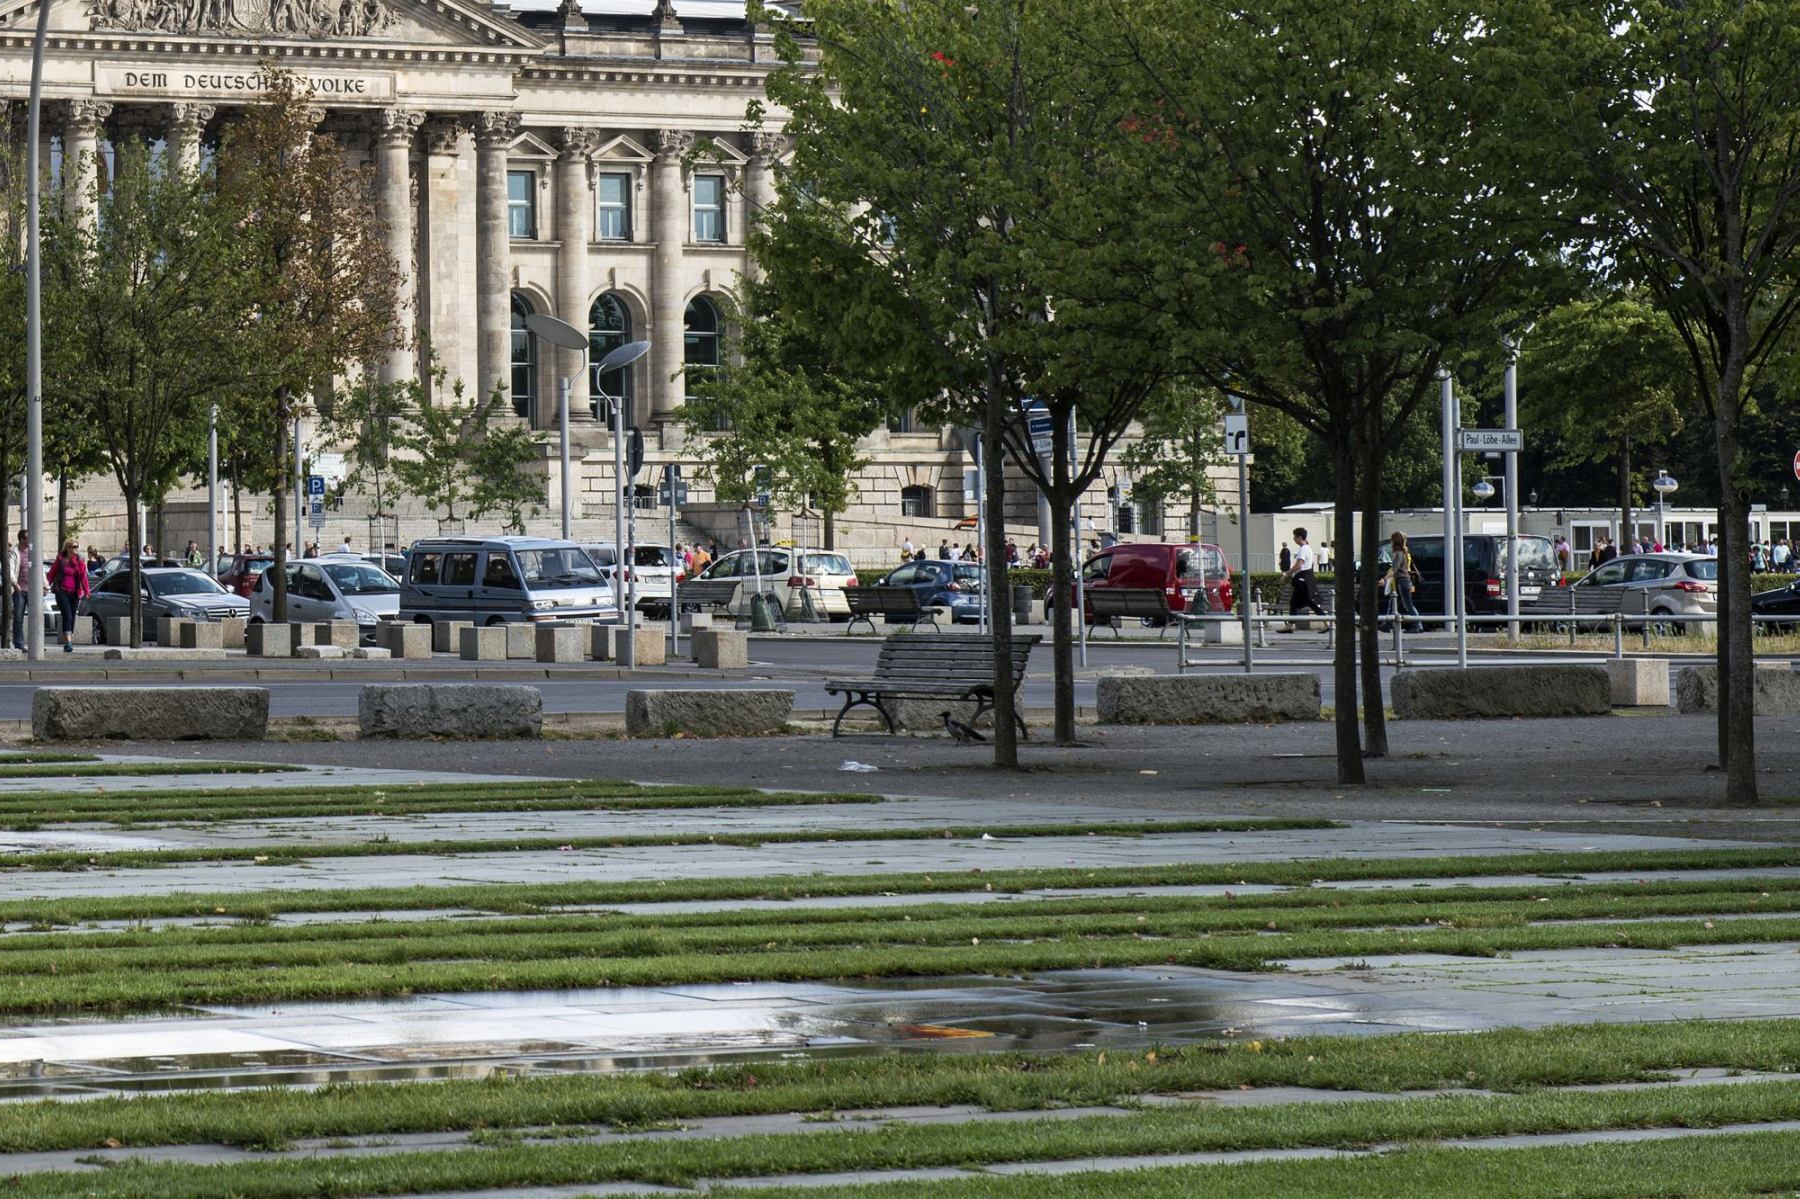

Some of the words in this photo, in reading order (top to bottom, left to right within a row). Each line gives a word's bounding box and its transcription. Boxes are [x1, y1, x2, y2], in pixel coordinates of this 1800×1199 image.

[125, 72, 167, 88] DEM
[184, 74, 293, 91] DEUTSCHN
[310, 78, 365, 94] VOLKE
[1466, 433, 1517, 445] Paul-Löbe-Allee
[312, 480, 321, 493] P
